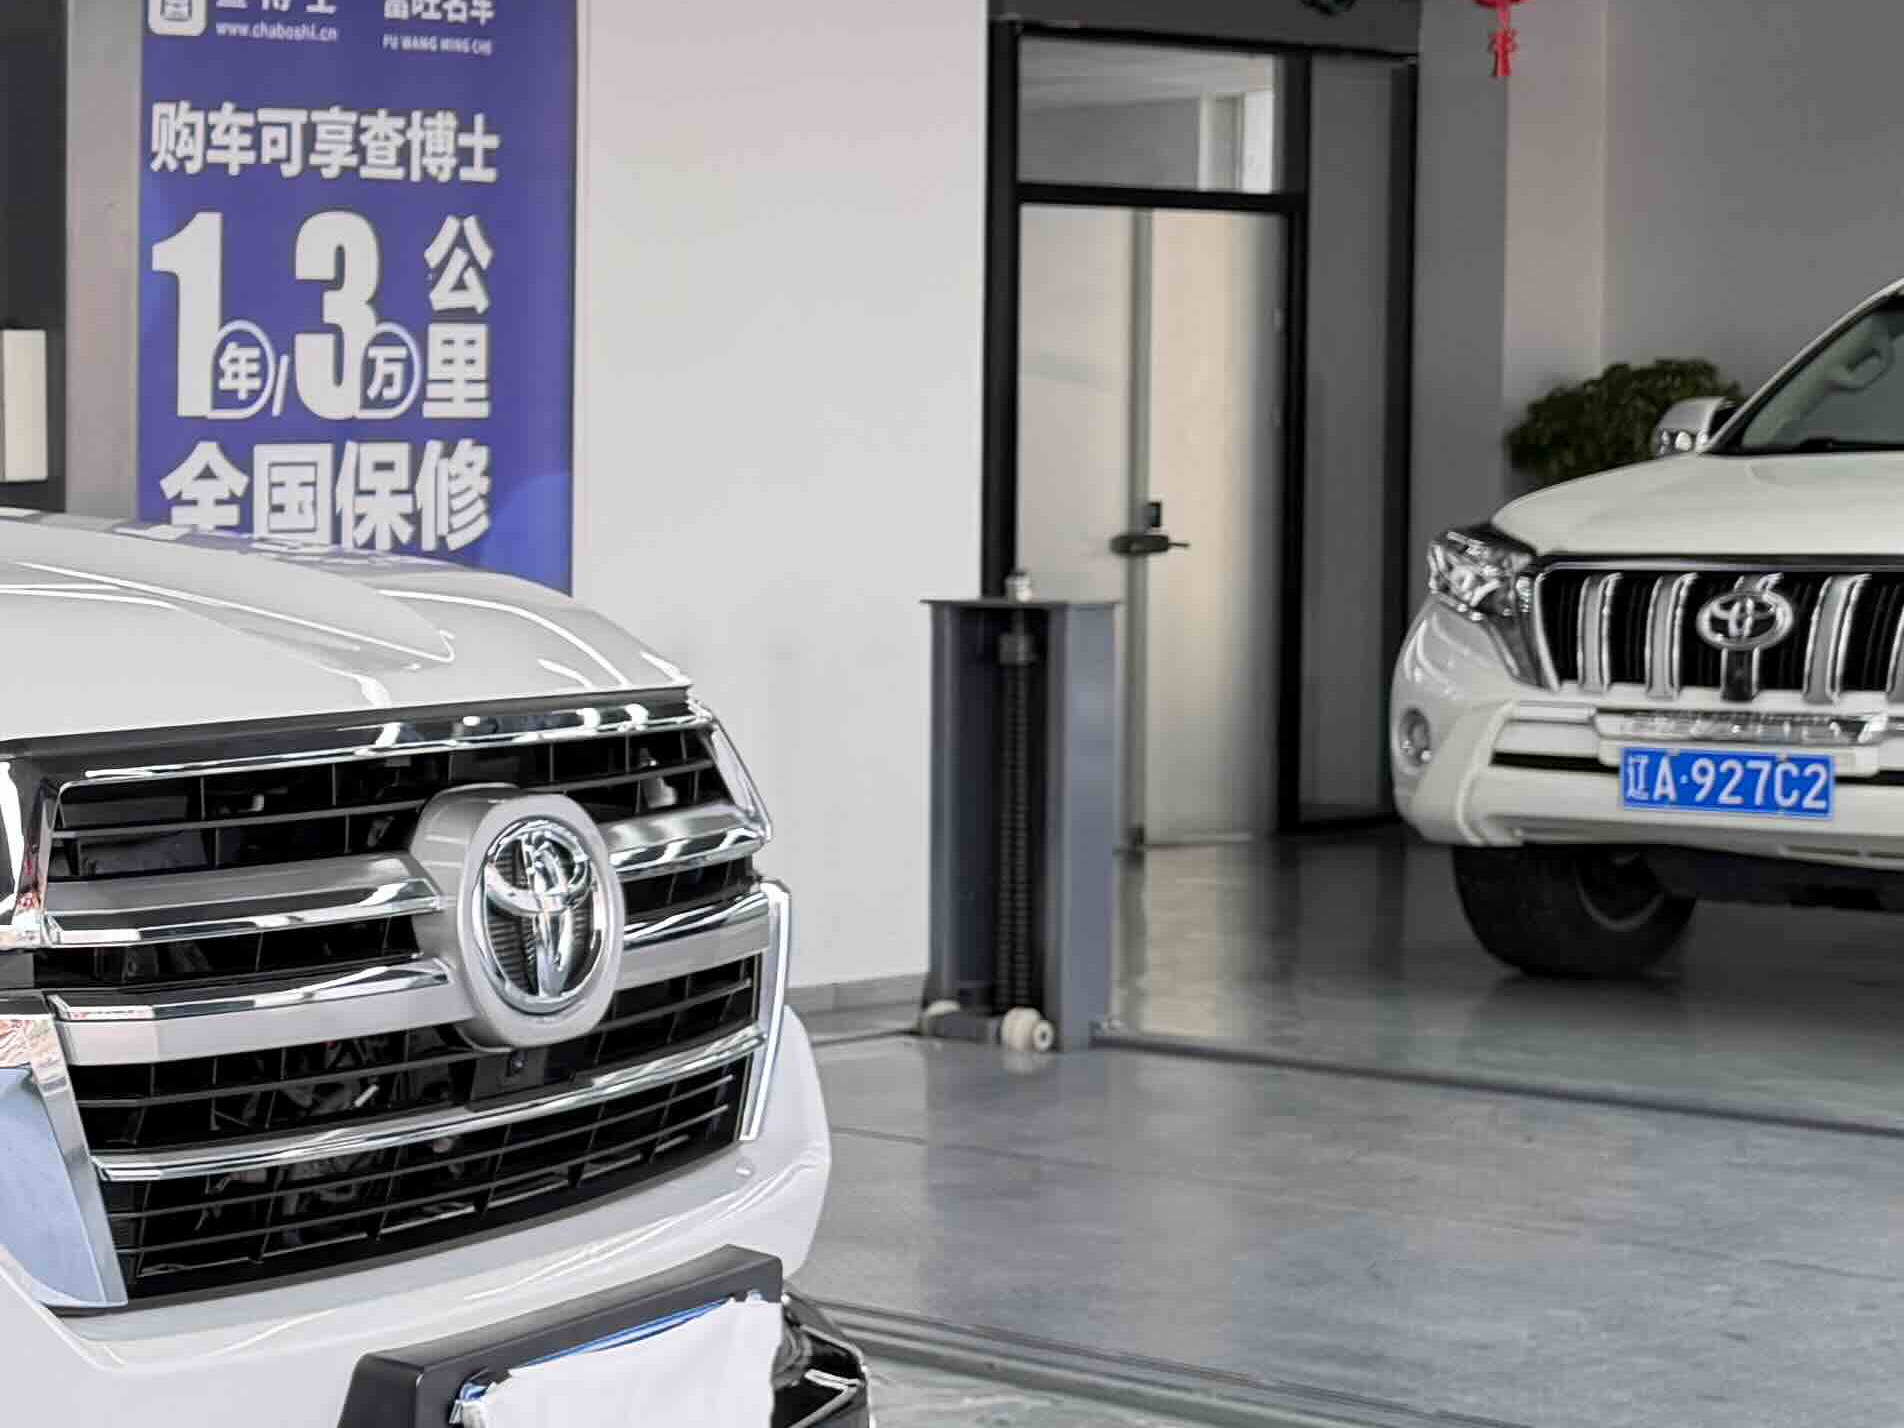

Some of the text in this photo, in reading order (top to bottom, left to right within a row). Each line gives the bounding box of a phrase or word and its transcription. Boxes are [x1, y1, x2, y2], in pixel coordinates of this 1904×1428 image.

[216, 21, 338, 42] www.chaboshi.cn
[150, 100, 500, 183] 购车可享查博士
[422, 214, 493, 419] 公里
[159, 440, 491, 551] 全国保修
